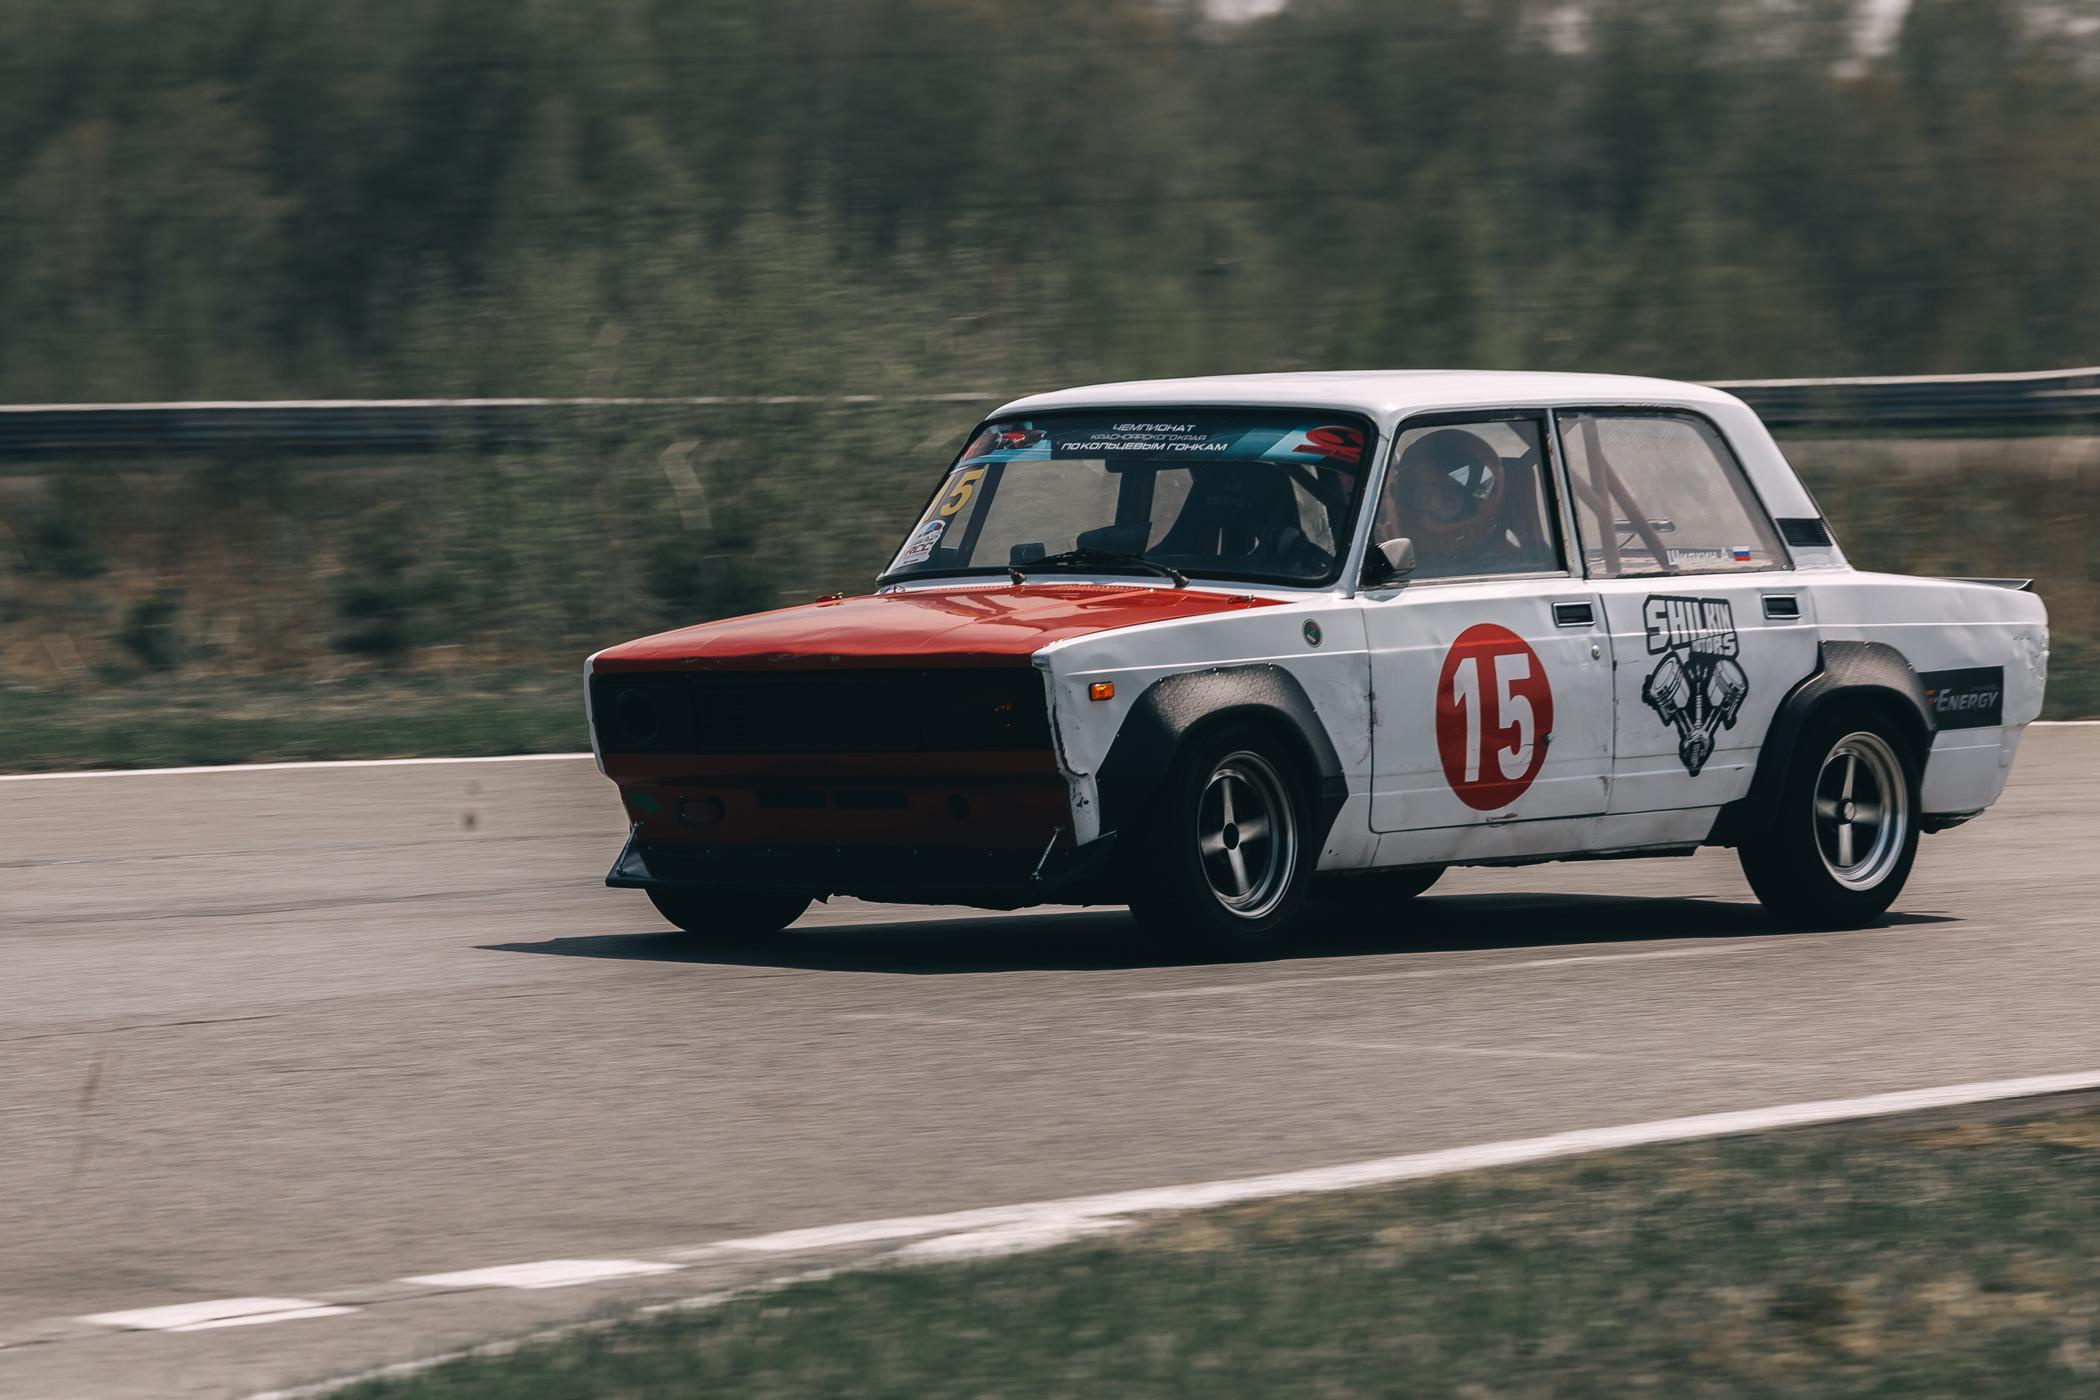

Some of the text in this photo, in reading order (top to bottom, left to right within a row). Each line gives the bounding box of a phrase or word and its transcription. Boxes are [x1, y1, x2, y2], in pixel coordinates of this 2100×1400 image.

[1112, 423, 1196, 432] ЧЕМПИОНАТ
[1061, 442, 1228, 451] ПО КОЛЬЦЕВЫМ ГОНКАМ
[1645, 599, 1732, 651] SHILKIN
[1453, 653, 1534, 782] 15
